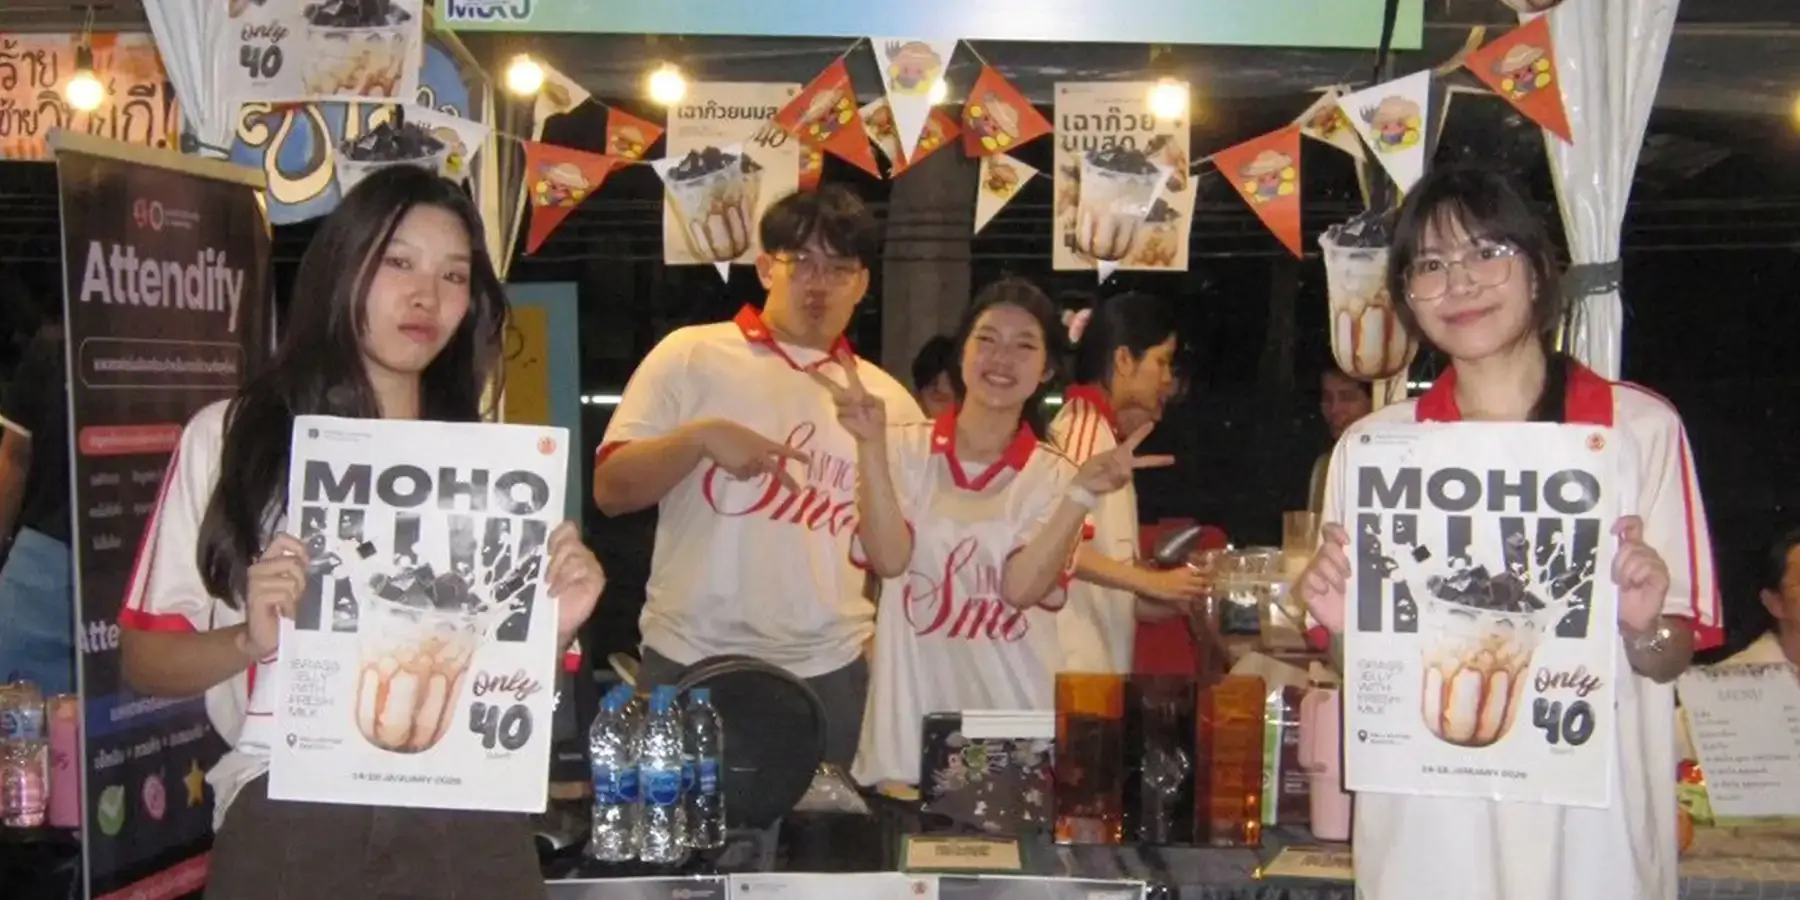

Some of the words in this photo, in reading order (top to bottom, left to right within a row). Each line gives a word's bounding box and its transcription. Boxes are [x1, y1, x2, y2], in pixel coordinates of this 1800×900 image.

[241, 19, 290, 44] only
[240, 44, 284, 79] 40
[1062, 106, 1156, 132] เฉาก๊วย
[752, 126, 788, 149] 40
[80, 241, 244, 333] Attendify
[302, 460, 550, 515] MOHO
[1357, 466, 1601, 514] MOHO
[472, 668, 542, 701] only
[1534, 666, 1604, 697] only
[468, 702, 534, 751] 40
[1532, 696, 1595, 746] 40
